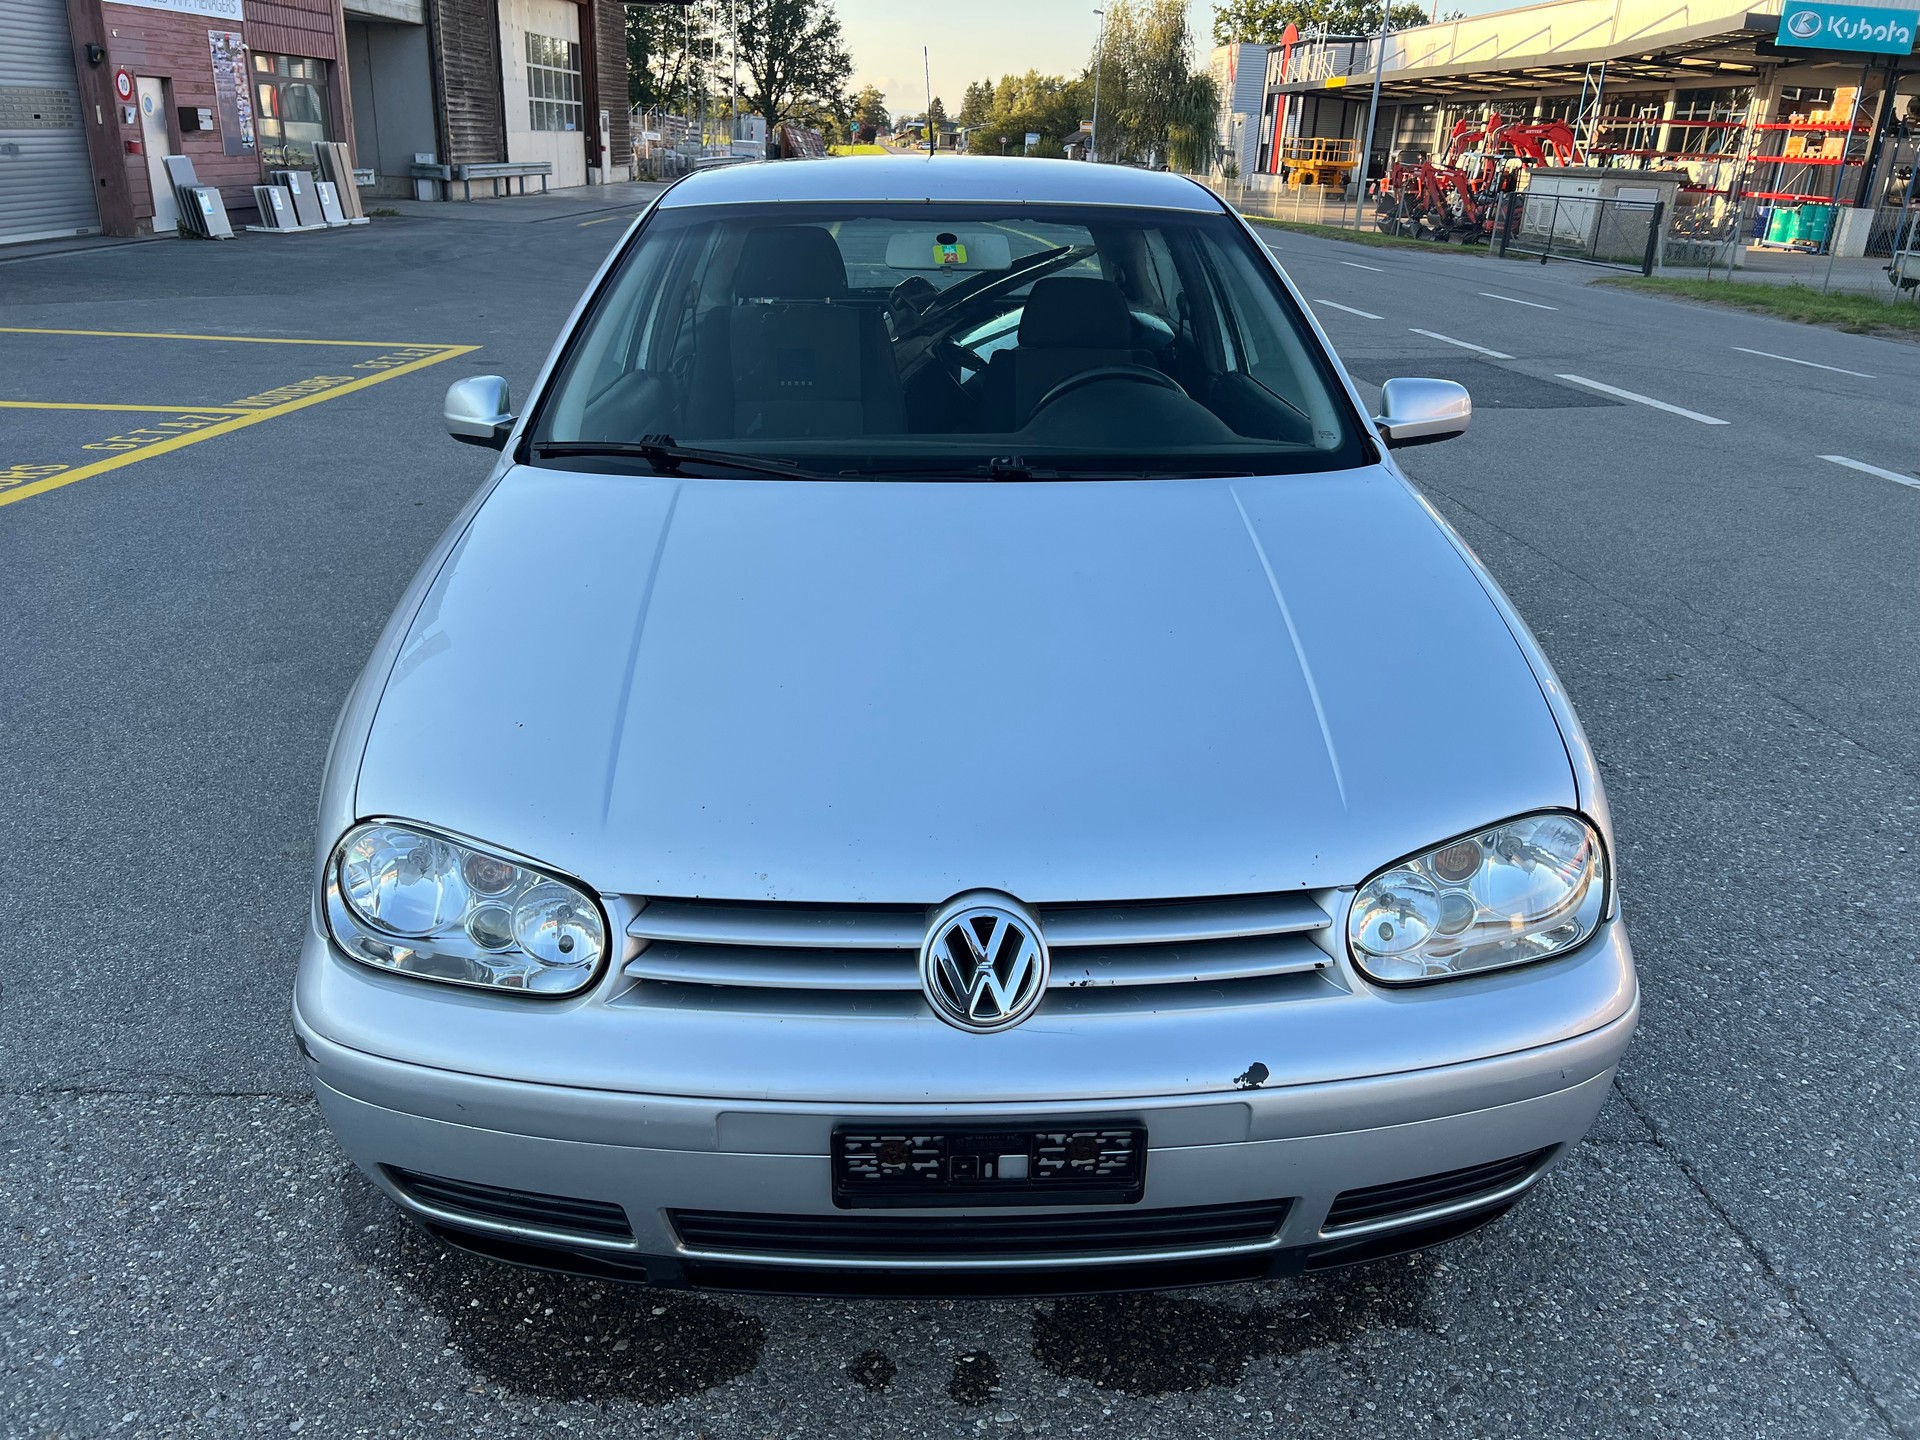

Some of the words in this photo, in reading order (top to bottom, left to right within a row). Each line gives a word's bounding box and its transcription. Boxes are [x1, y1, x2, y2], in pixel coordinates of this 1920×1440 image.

[1827, 15, 1910, 43] Kubota
[120, 79, 128, 92] 10
[943, 253, 959, 263] 23
[352, 347, 443, 369] GETAZ
[81, 414, 232, 450] GETAZ
